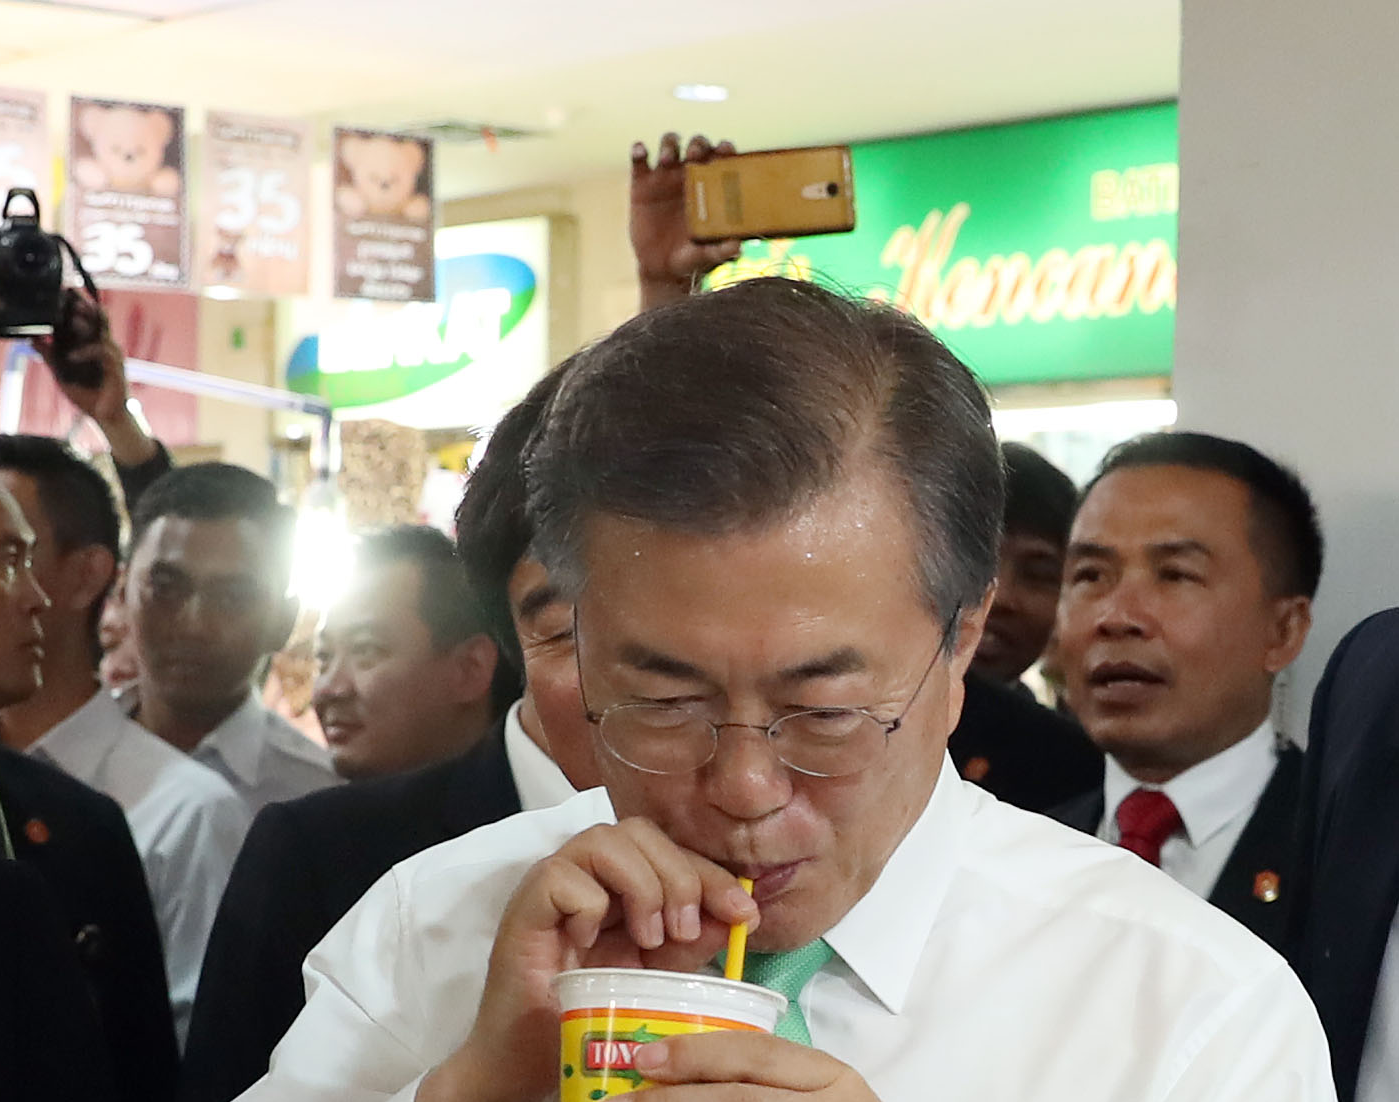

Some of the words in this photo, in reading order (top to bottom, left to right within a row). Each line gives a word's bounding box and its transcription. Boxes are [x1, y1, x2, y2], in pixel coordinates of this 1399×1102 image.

[213, 168, 301, 233] 35
[81, 221, 154, 277] 35
[591, 1040, 644, 1066] TON
